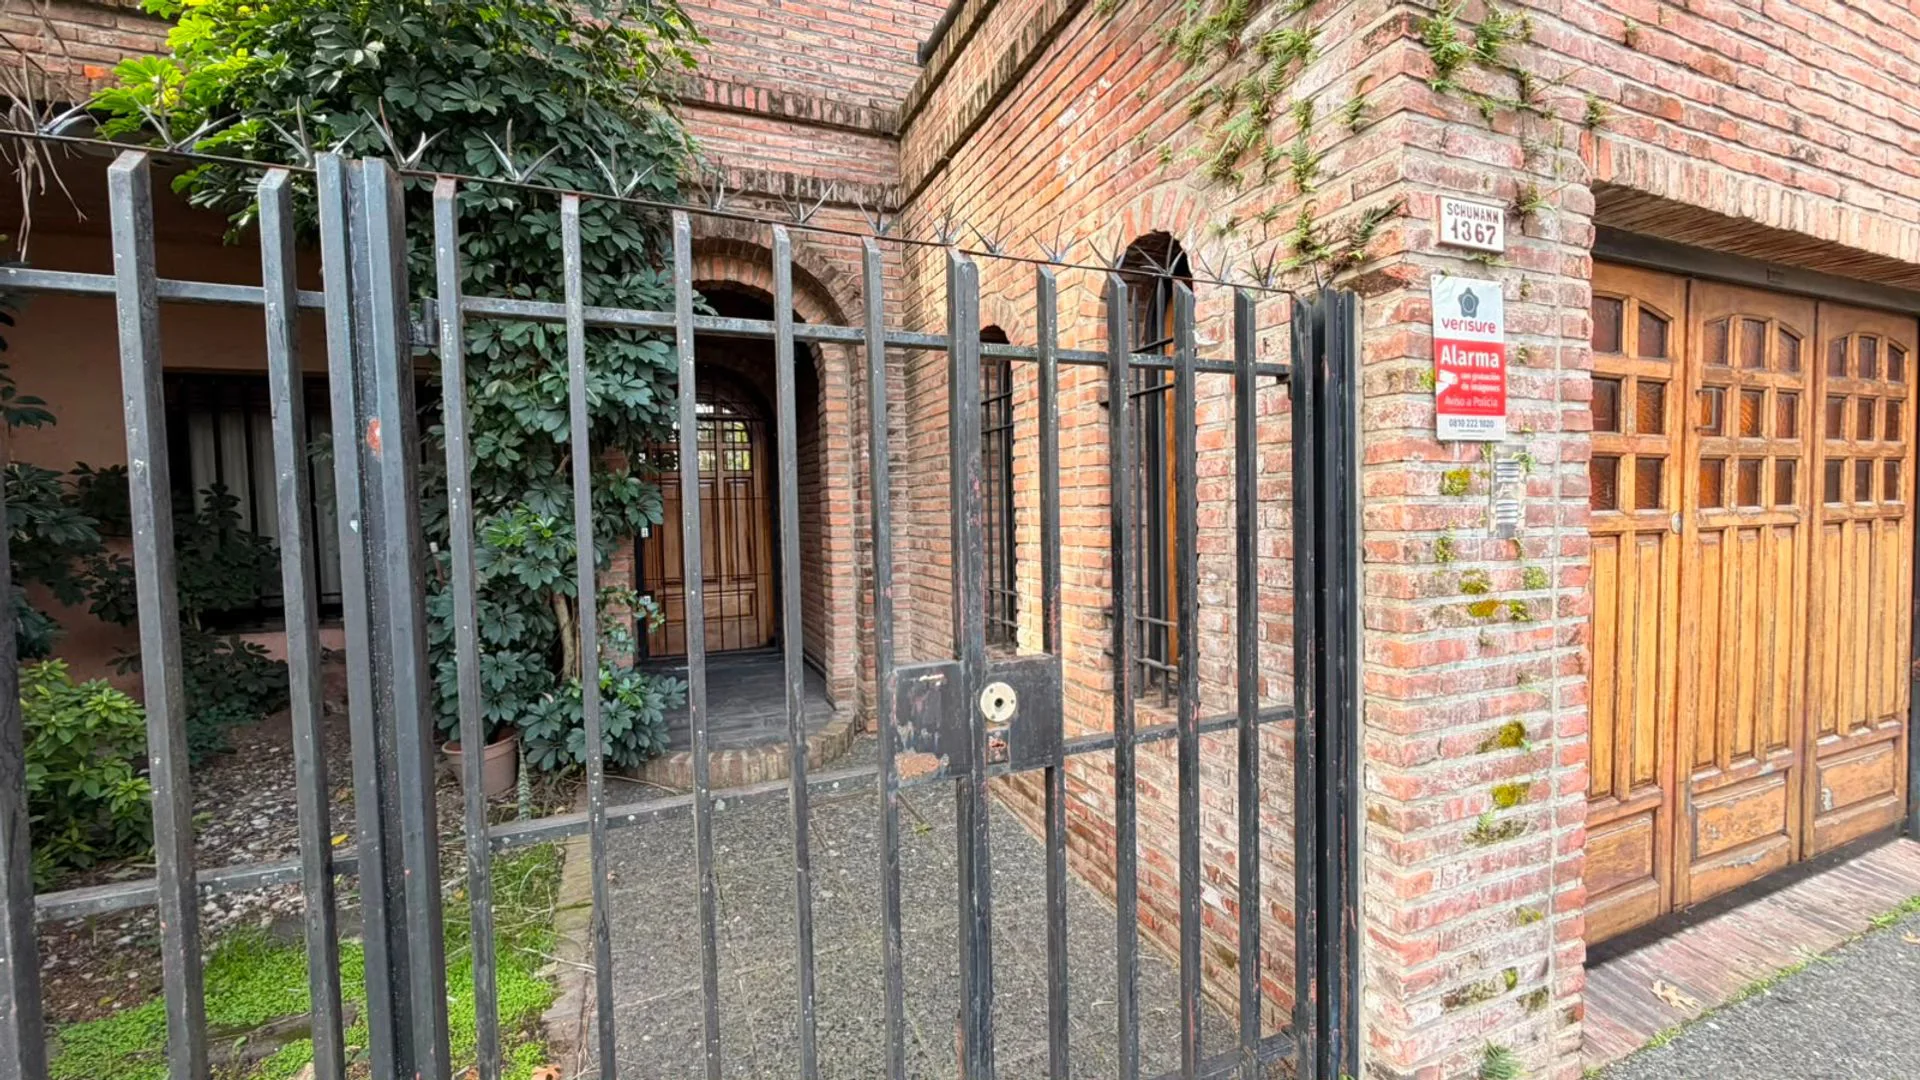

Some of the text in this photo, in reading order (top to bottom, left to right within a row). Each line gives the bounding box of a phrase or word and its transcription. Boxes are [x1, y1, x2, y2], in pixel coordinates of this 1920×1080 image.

[1446, 203, 1499, 224] SCHUMANN
[1450, 218, 1496, 244] 1367
[1441, 317, 1496, 334] verisure
[1440, 344, 1499, 368] Alarma
[1444, 395, 1465, 406] Aviso
